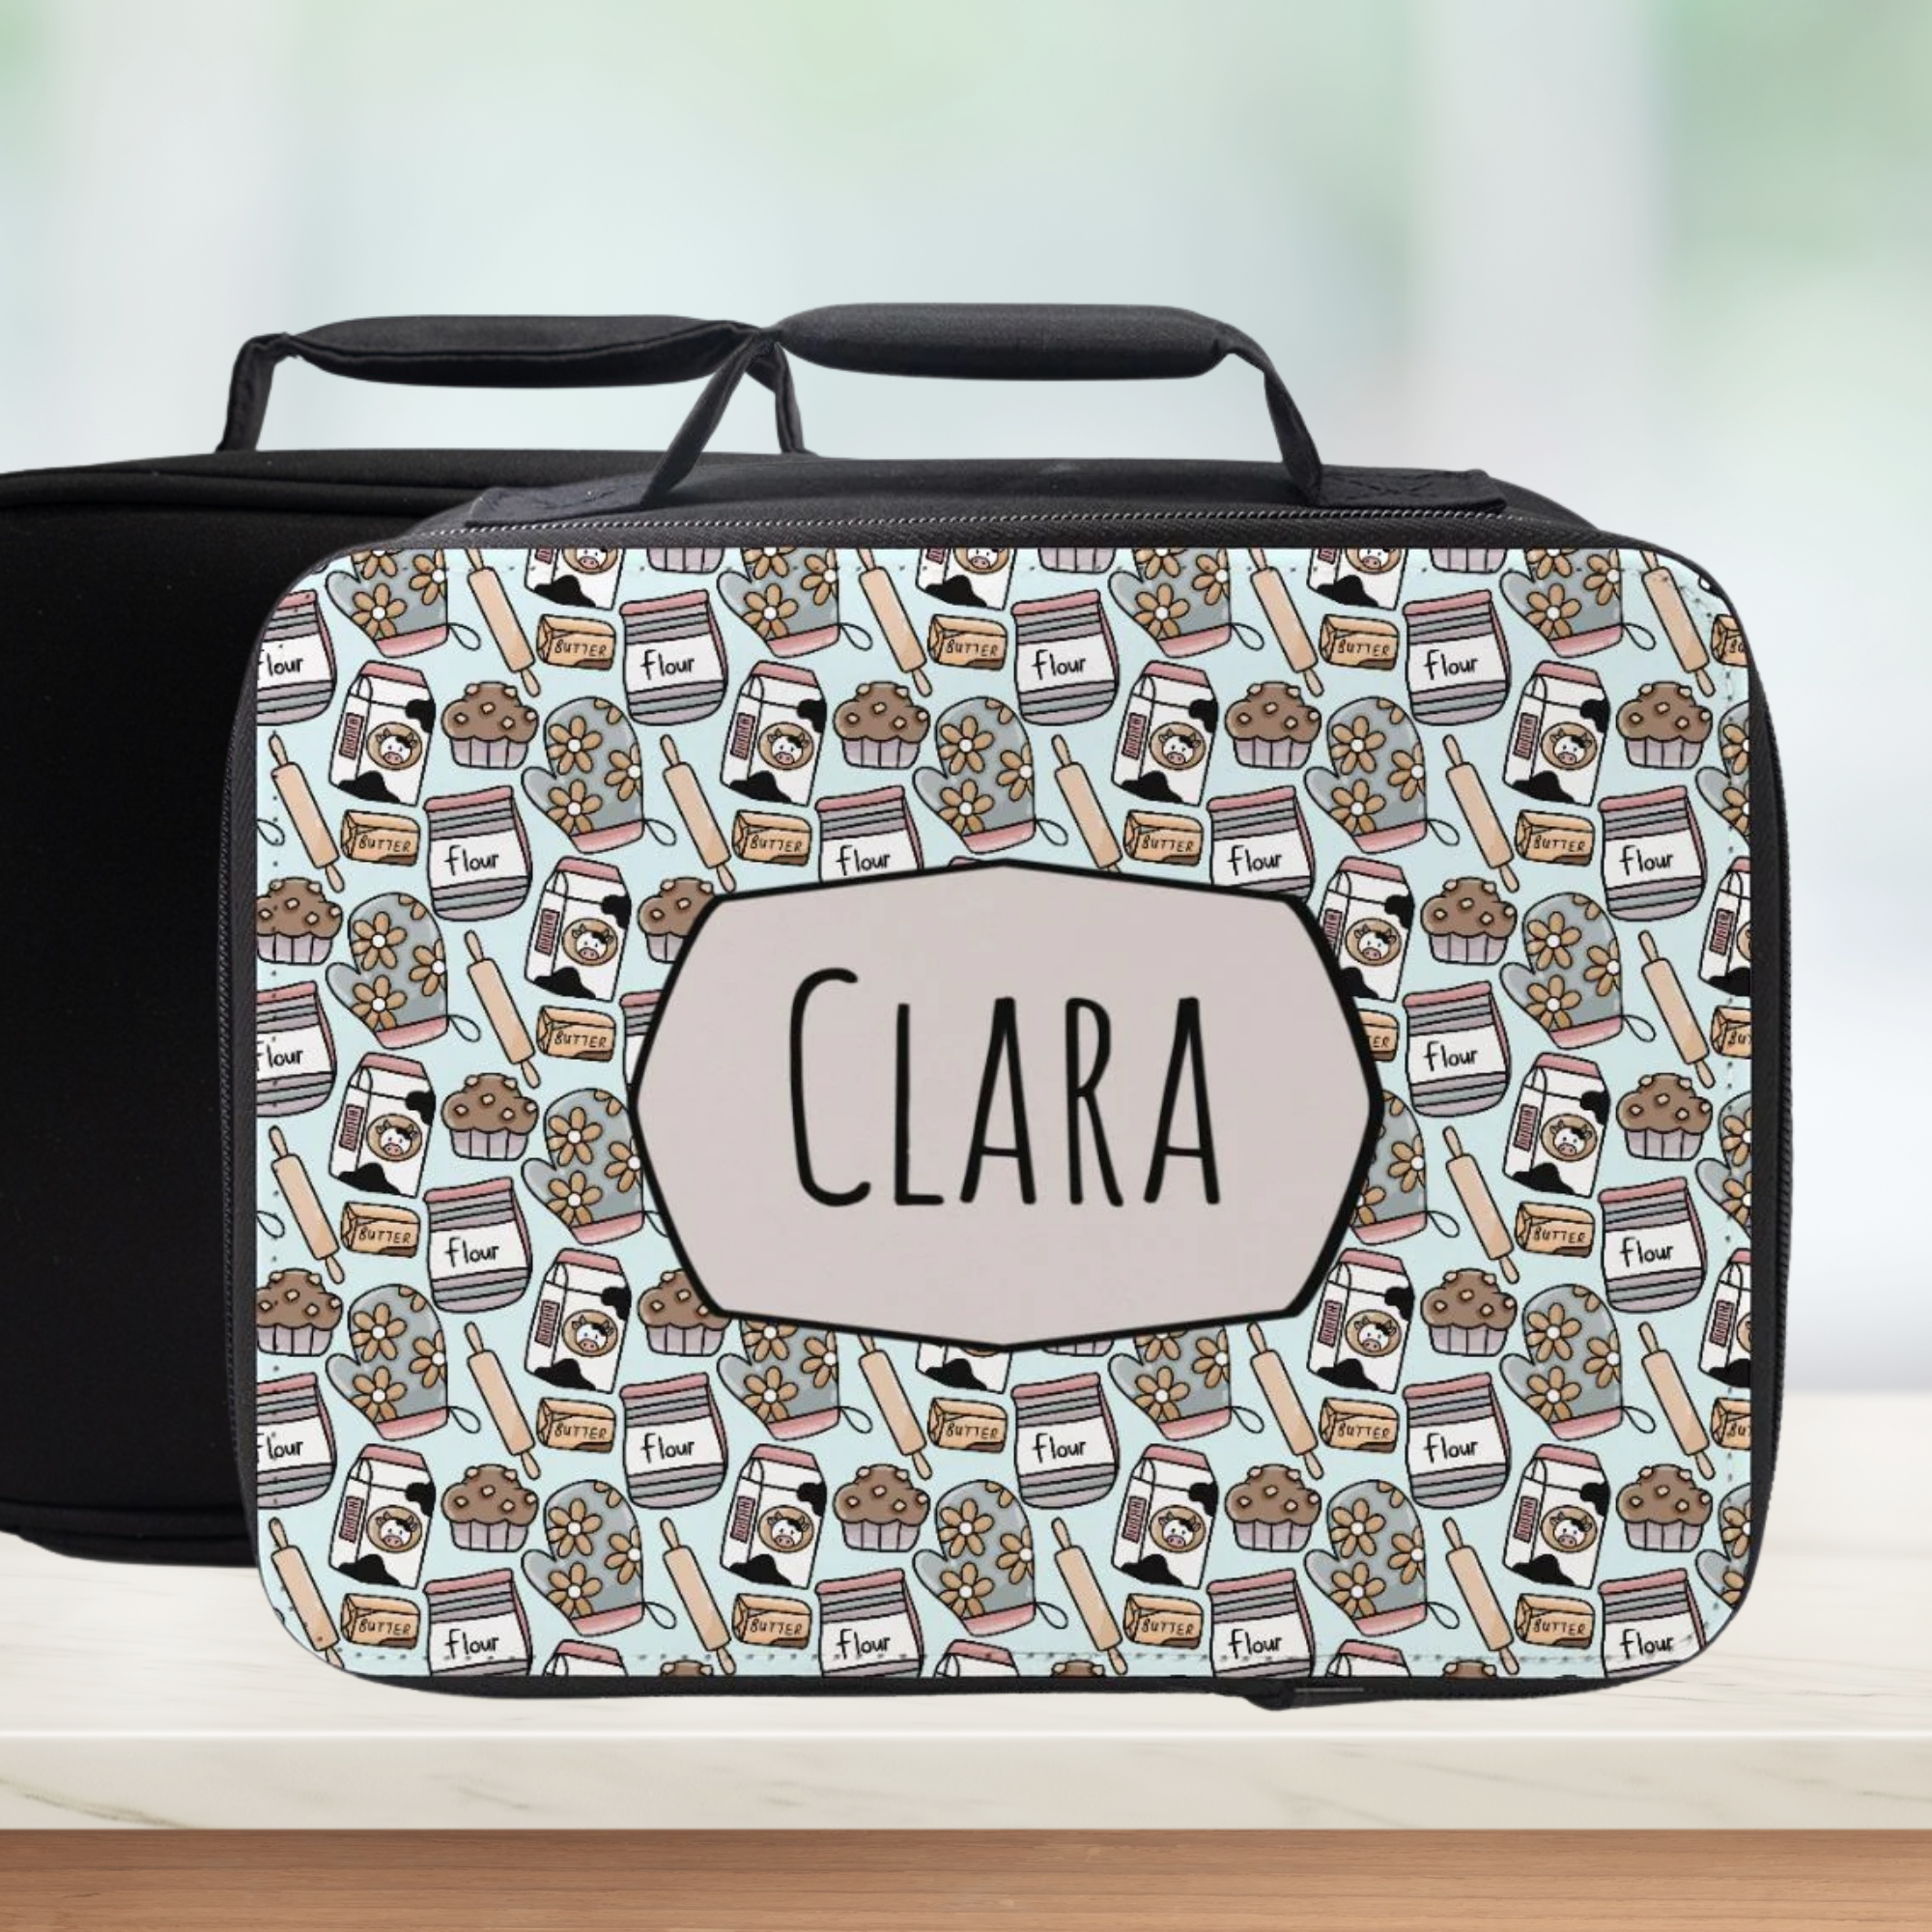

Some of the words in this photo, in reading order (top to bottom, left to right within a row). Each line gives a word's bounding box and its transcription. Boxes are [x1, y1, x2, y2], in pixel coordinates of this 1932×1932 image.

[554, 639, 607, 658] BUTTER
[946, 639, 998, 658] BUTTER
[1338, 639, 1390, 658] BUTTER
[639, 649, 695, 680] flour
[1031, 649, 1086, 680] flour
[1422, 649, 1477, 680] flour
[358, 835, 411, 854] BUTTER
[751, 835, 803, 854] BUTTER
[836, 844, 891, 875] flour
[1142, 835, 1194, 854] BUTTER
[1533, 835, 1585, 854] BUTTER
[443, 845, 498, 876] flour
[1227, 845, 1282, 876] flour
[1618, 845, 1673, 876] flour
[554, 1030, 607, 1049] BUTTER
[1422, 1040, 1477, 1071] flour
[789, 967, 1220, 1208] CLARA
[358, 1226, 411, 1245] BUTTER
[1533, 1226, 1585, 1245] BUTTER
[443, 1236, 498, 1267] flour
[1618, 1236, 1673, 1267] flour
[554, 1422, 607, 1441] BUTTER
[946, 1422, 998, 1441] BUTTER
[1337, 1422, 1389, 1441] BUTTER
[639, 1433, 695, 1463] flour
[1031, 1433, 1086, 1463] flour
[1422, 1433, 1477, 1463] flour
[358, 1617, 411, 1636] BUTTER
[751, 1617, 803, 1636] BUTTER
[1142, 1617, 1194, 1636] BUTTER
[1533, 1617, 1585, 1636] BUTTER
[443, 1628, 498, 1659] flour
[836, 1628, 891, 1659] flour
[1227, 1628, 1282, 1659] flour
[1618, 1628, 1673, 1659] flour
